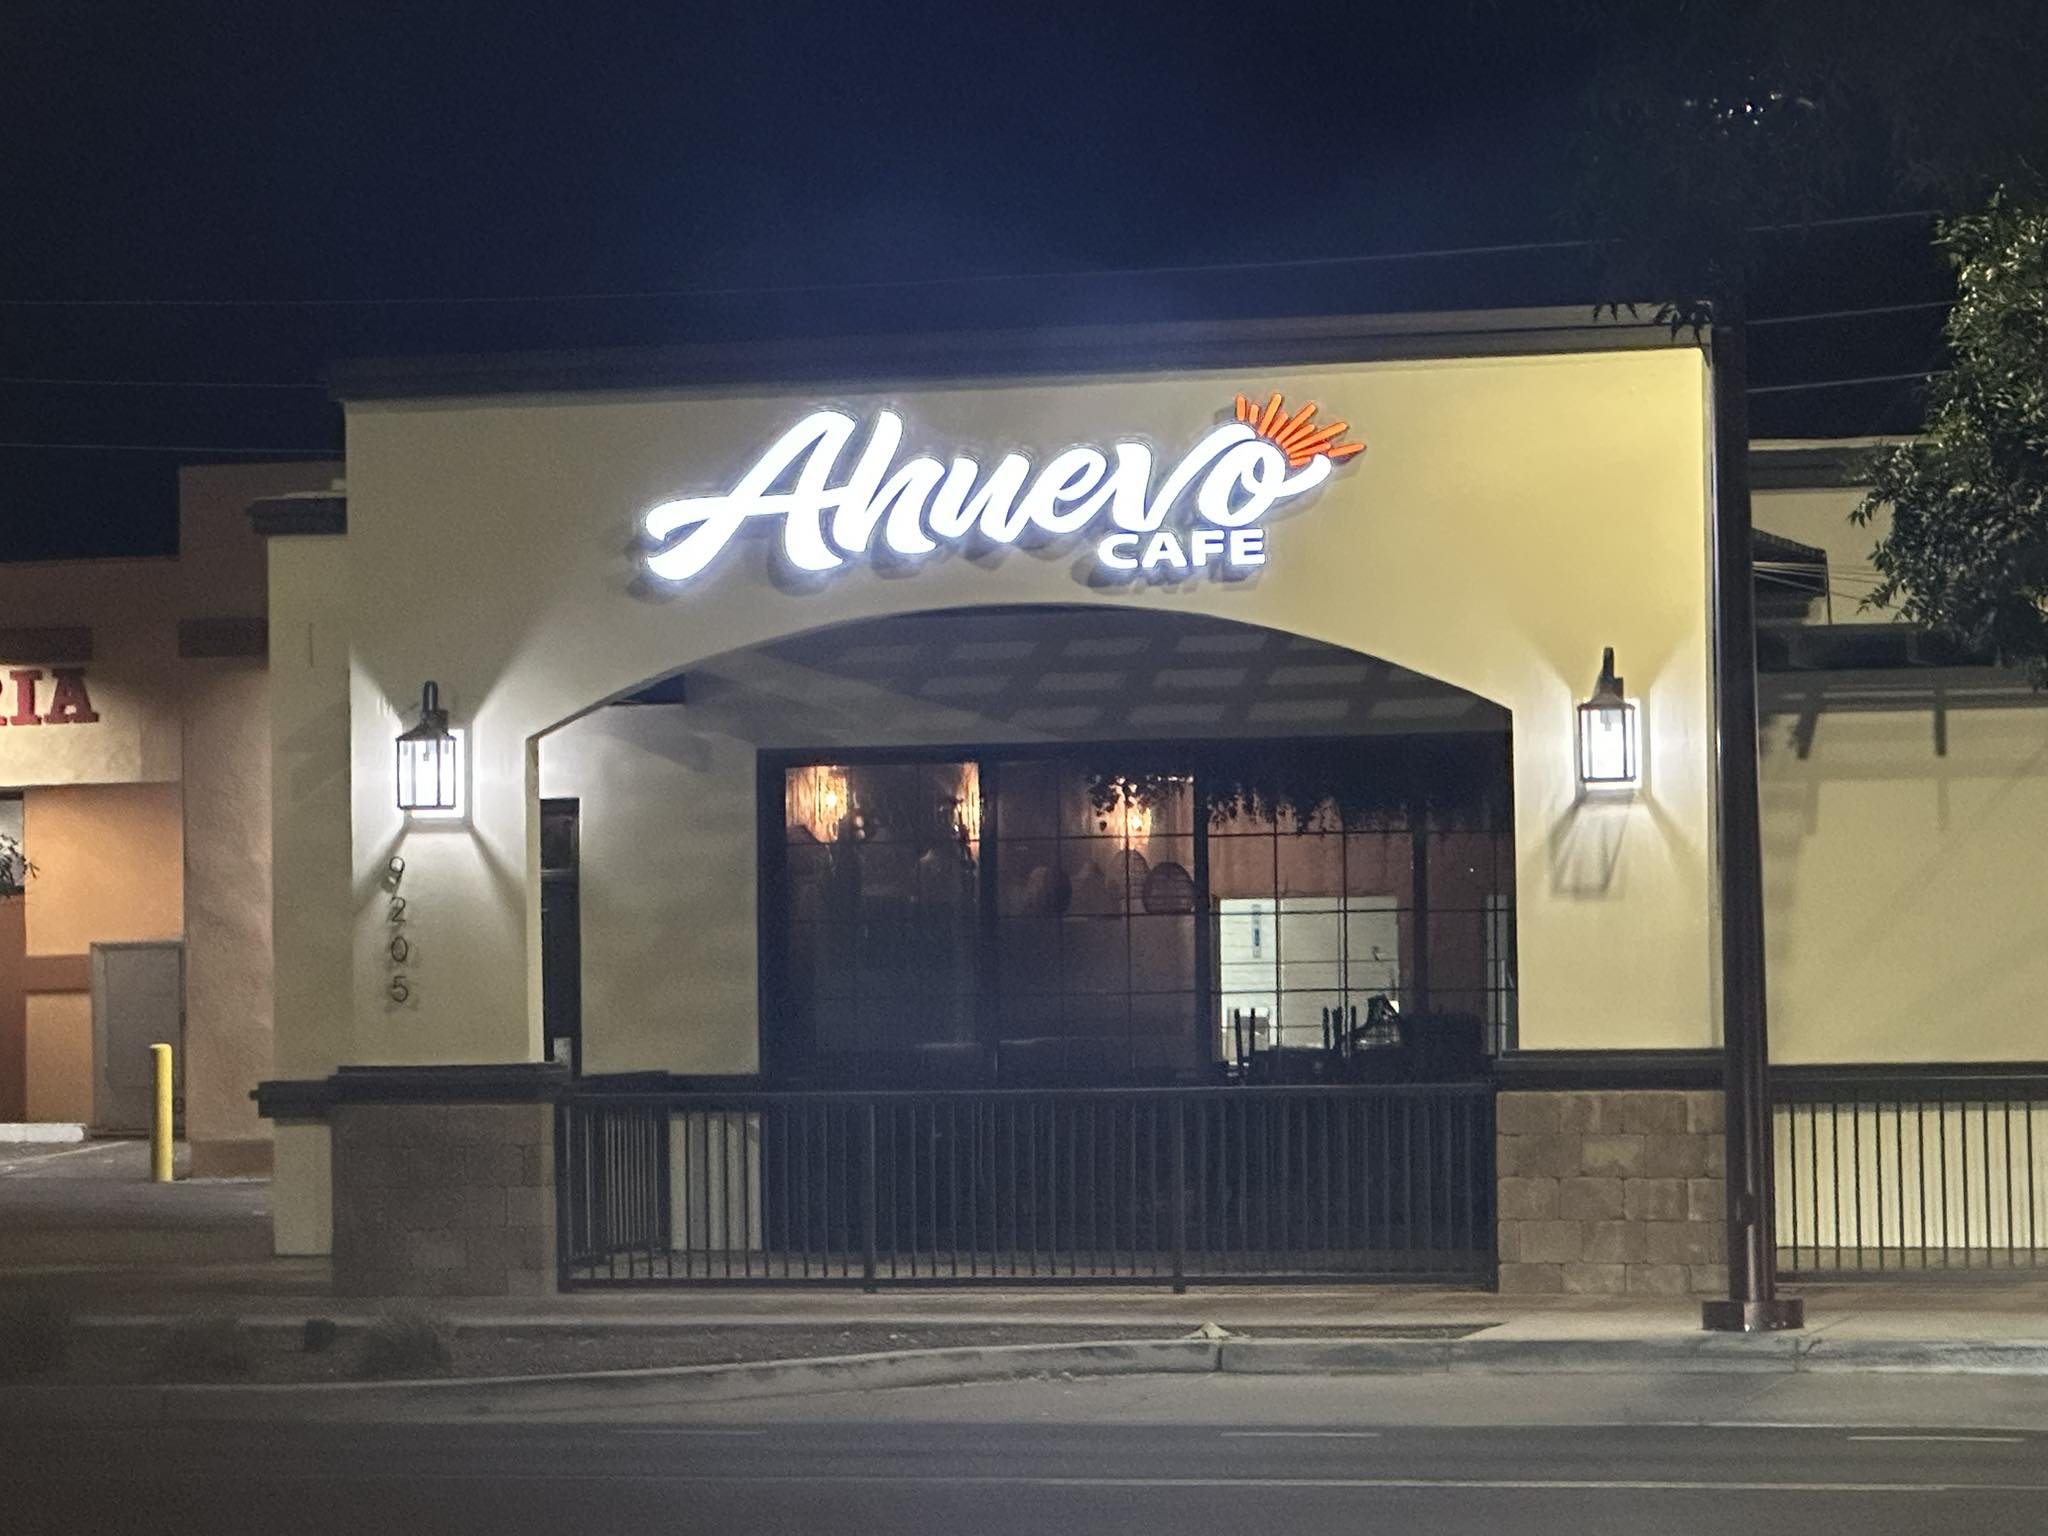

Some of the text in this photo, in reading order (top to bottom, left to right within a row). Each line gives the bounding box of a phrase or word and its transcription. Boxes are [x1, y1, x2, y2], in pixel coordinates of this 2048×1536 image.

[646, 409, 1331, 581] Ahuevo
[1097, 528, 1266, 569] CAFE
[0, 668, 98, 725] IA
[389, 856, 409, 1003] 9205
